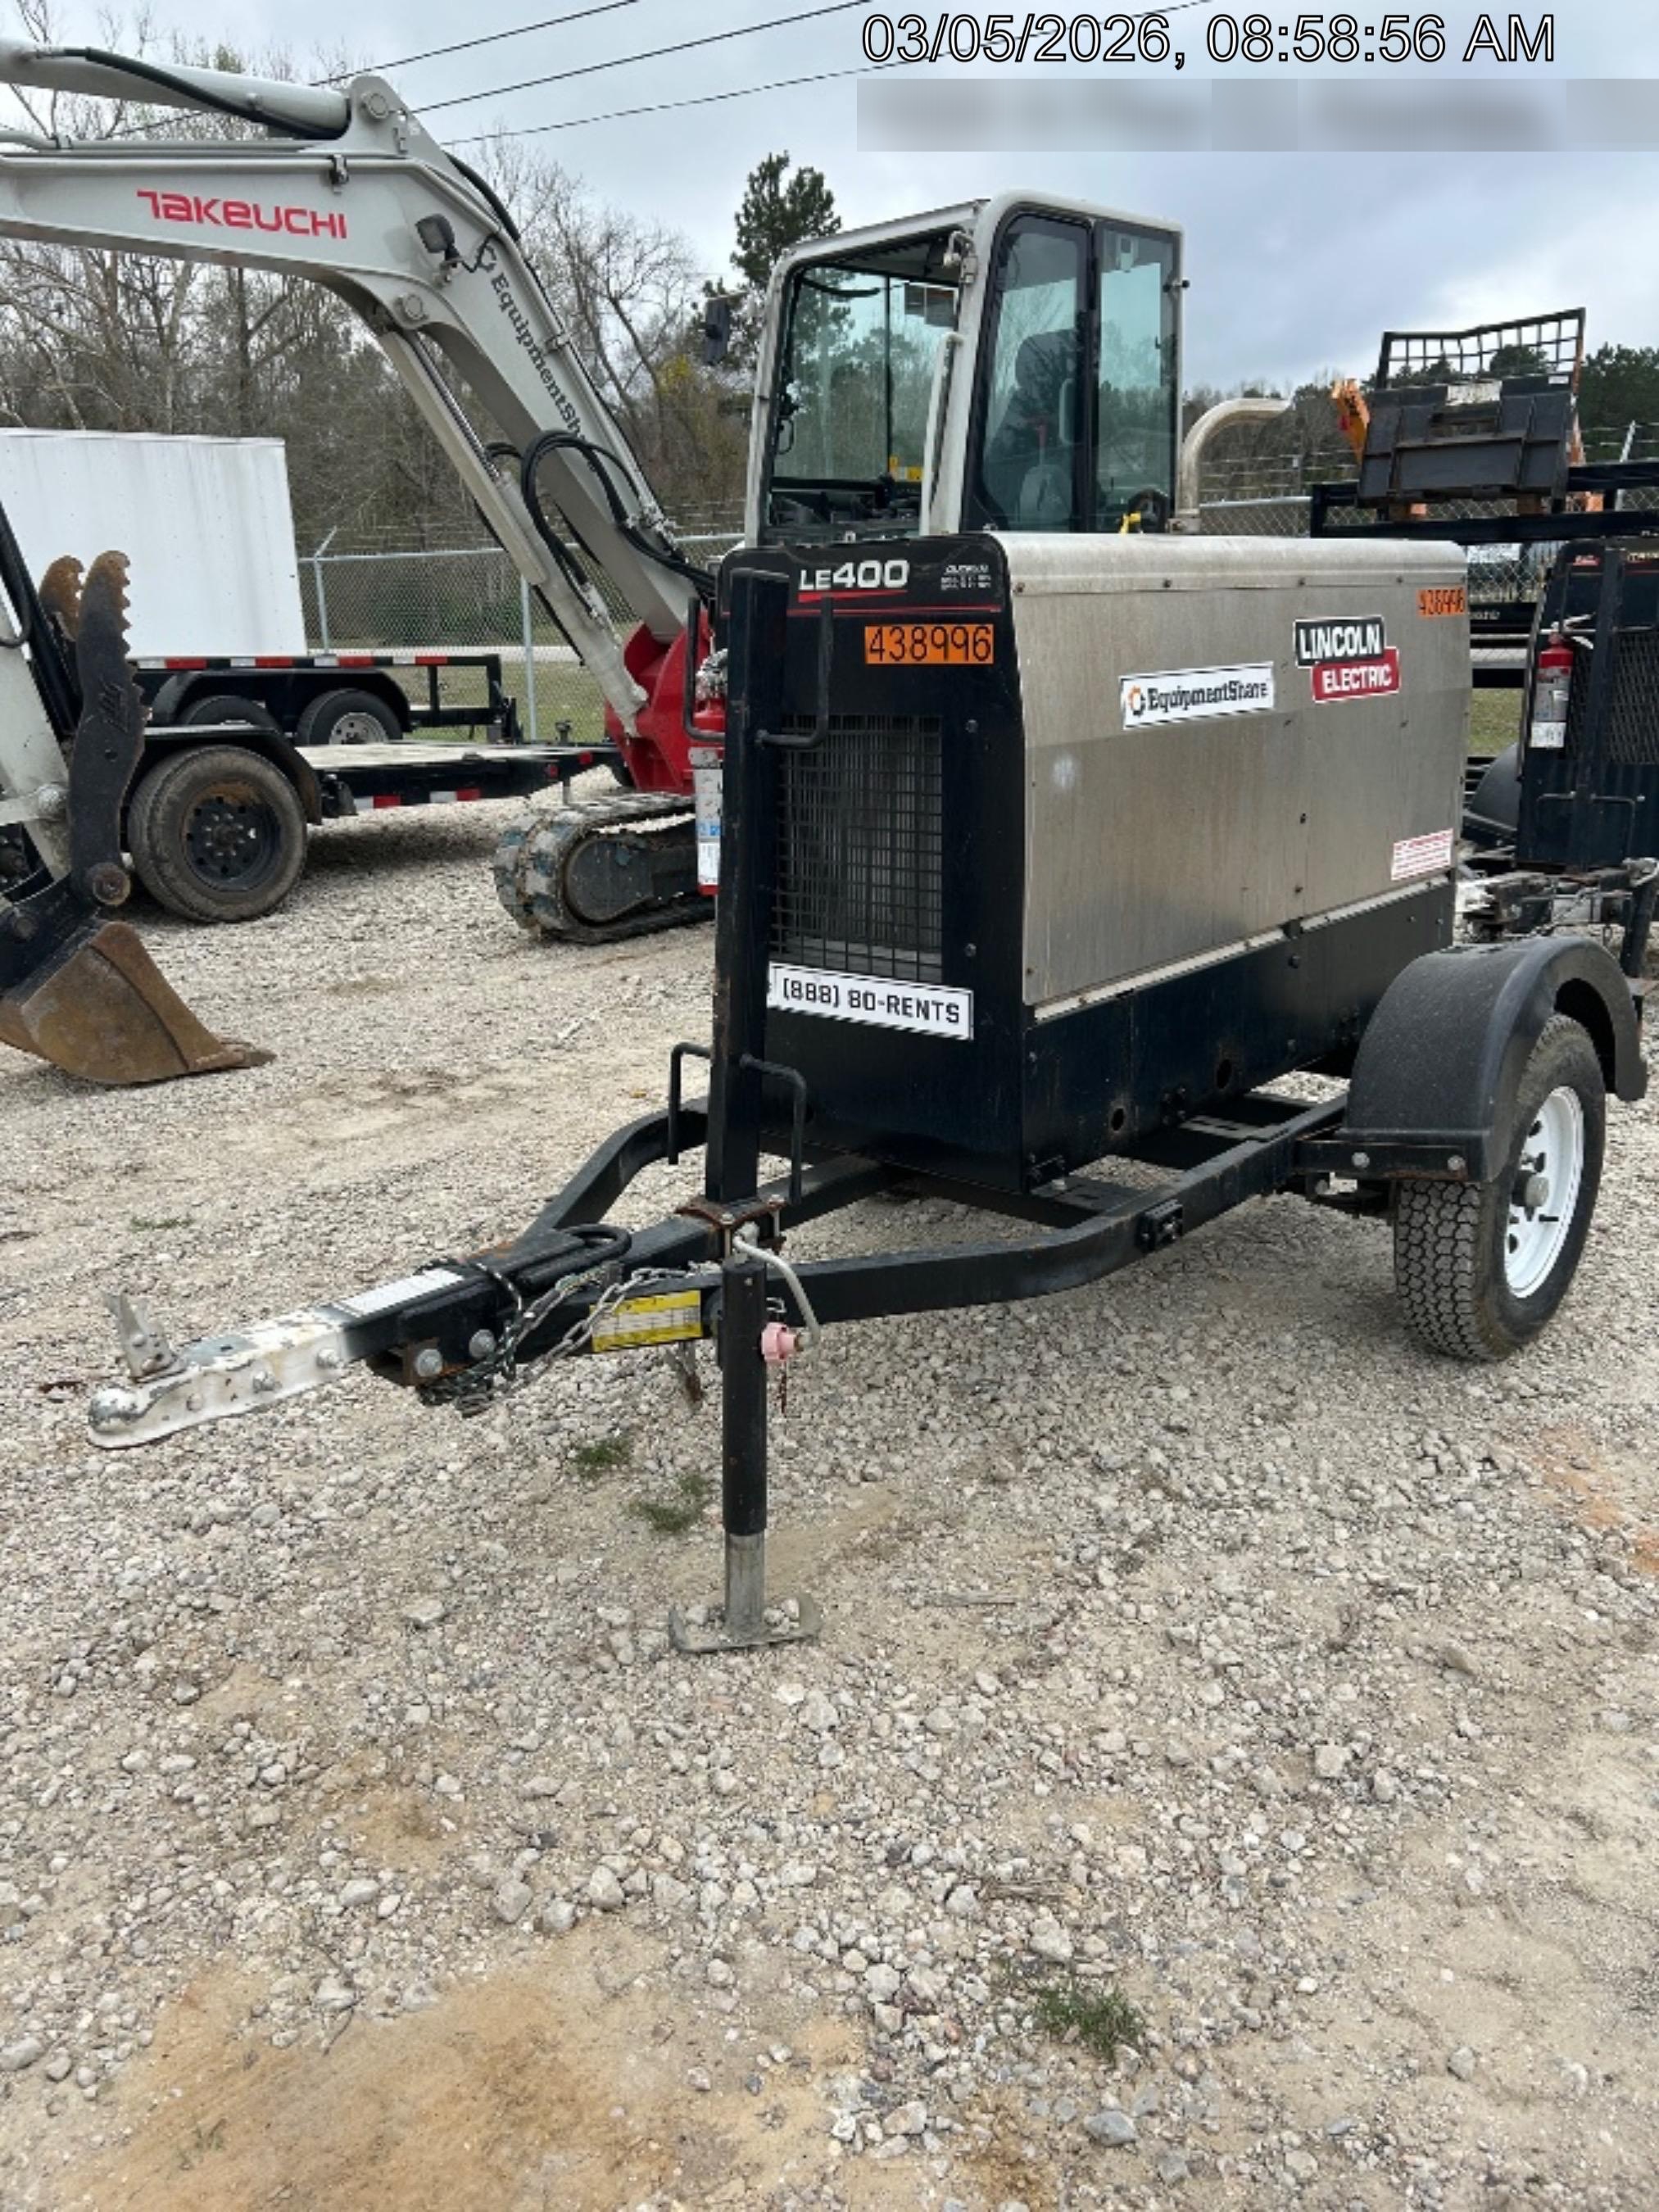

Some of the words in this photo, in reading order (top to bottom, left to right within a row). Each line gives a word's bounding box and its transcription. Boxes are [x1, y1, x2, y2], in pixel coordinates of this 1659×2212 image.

[798, 560, 910, 591] LE400
[868, 626, 991, 662] 438996
[1299, 623, 1381, 660] LINCOLN
[1322, 664, 1393, 695] ELECTRIC
[783, 977, 839, 1009] (888)
